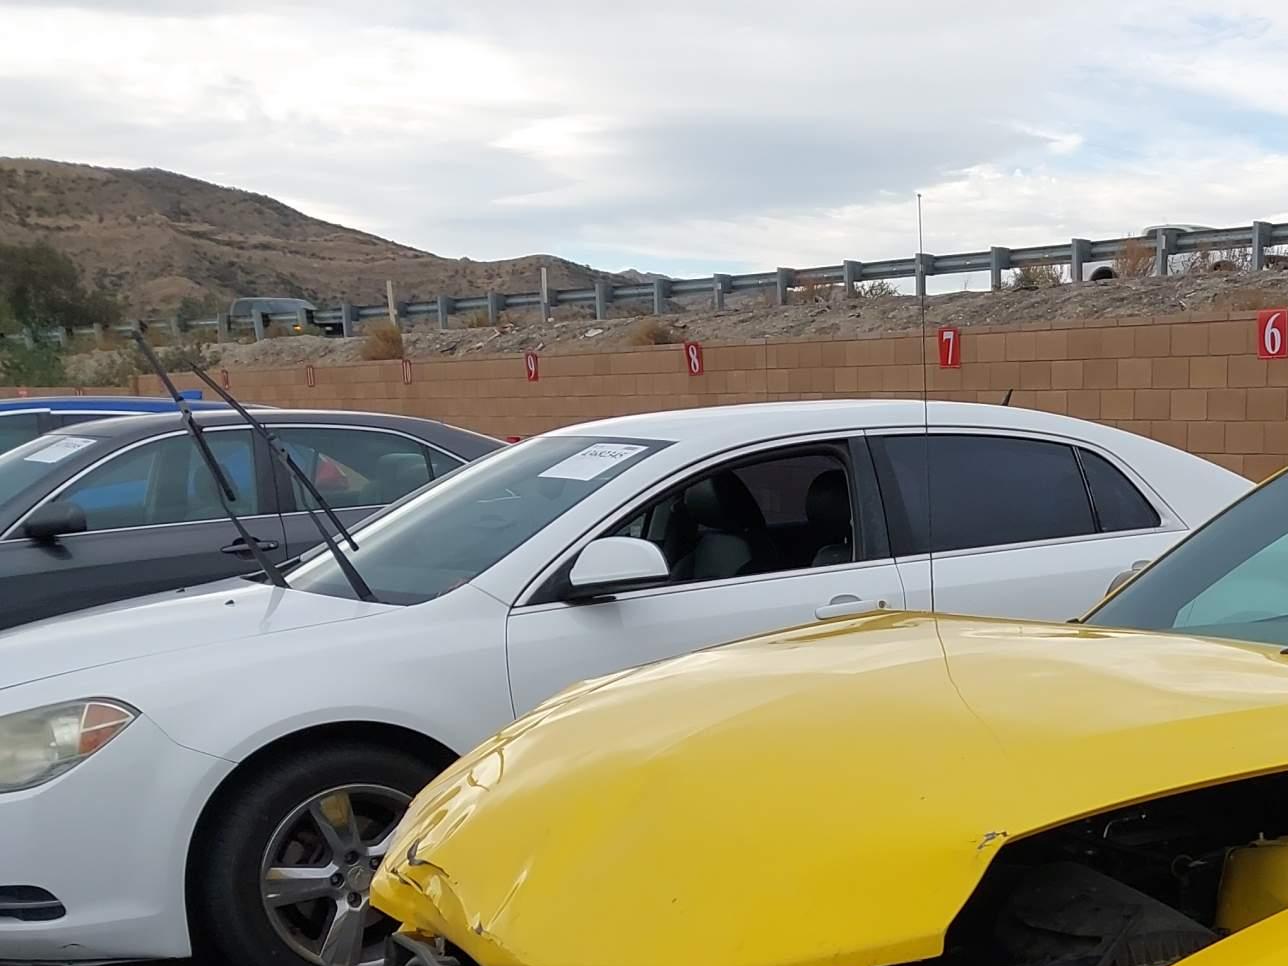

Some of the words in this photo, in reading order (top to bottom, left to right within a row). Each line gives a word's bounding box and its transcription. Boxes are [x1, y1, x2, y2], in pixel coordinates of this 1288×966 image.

[943, 331, 954, 365] 7
[1264, 312, 1281, 354] 6
[527, 354, 535, 379] 9
[689, 344, 700, 373] 8
